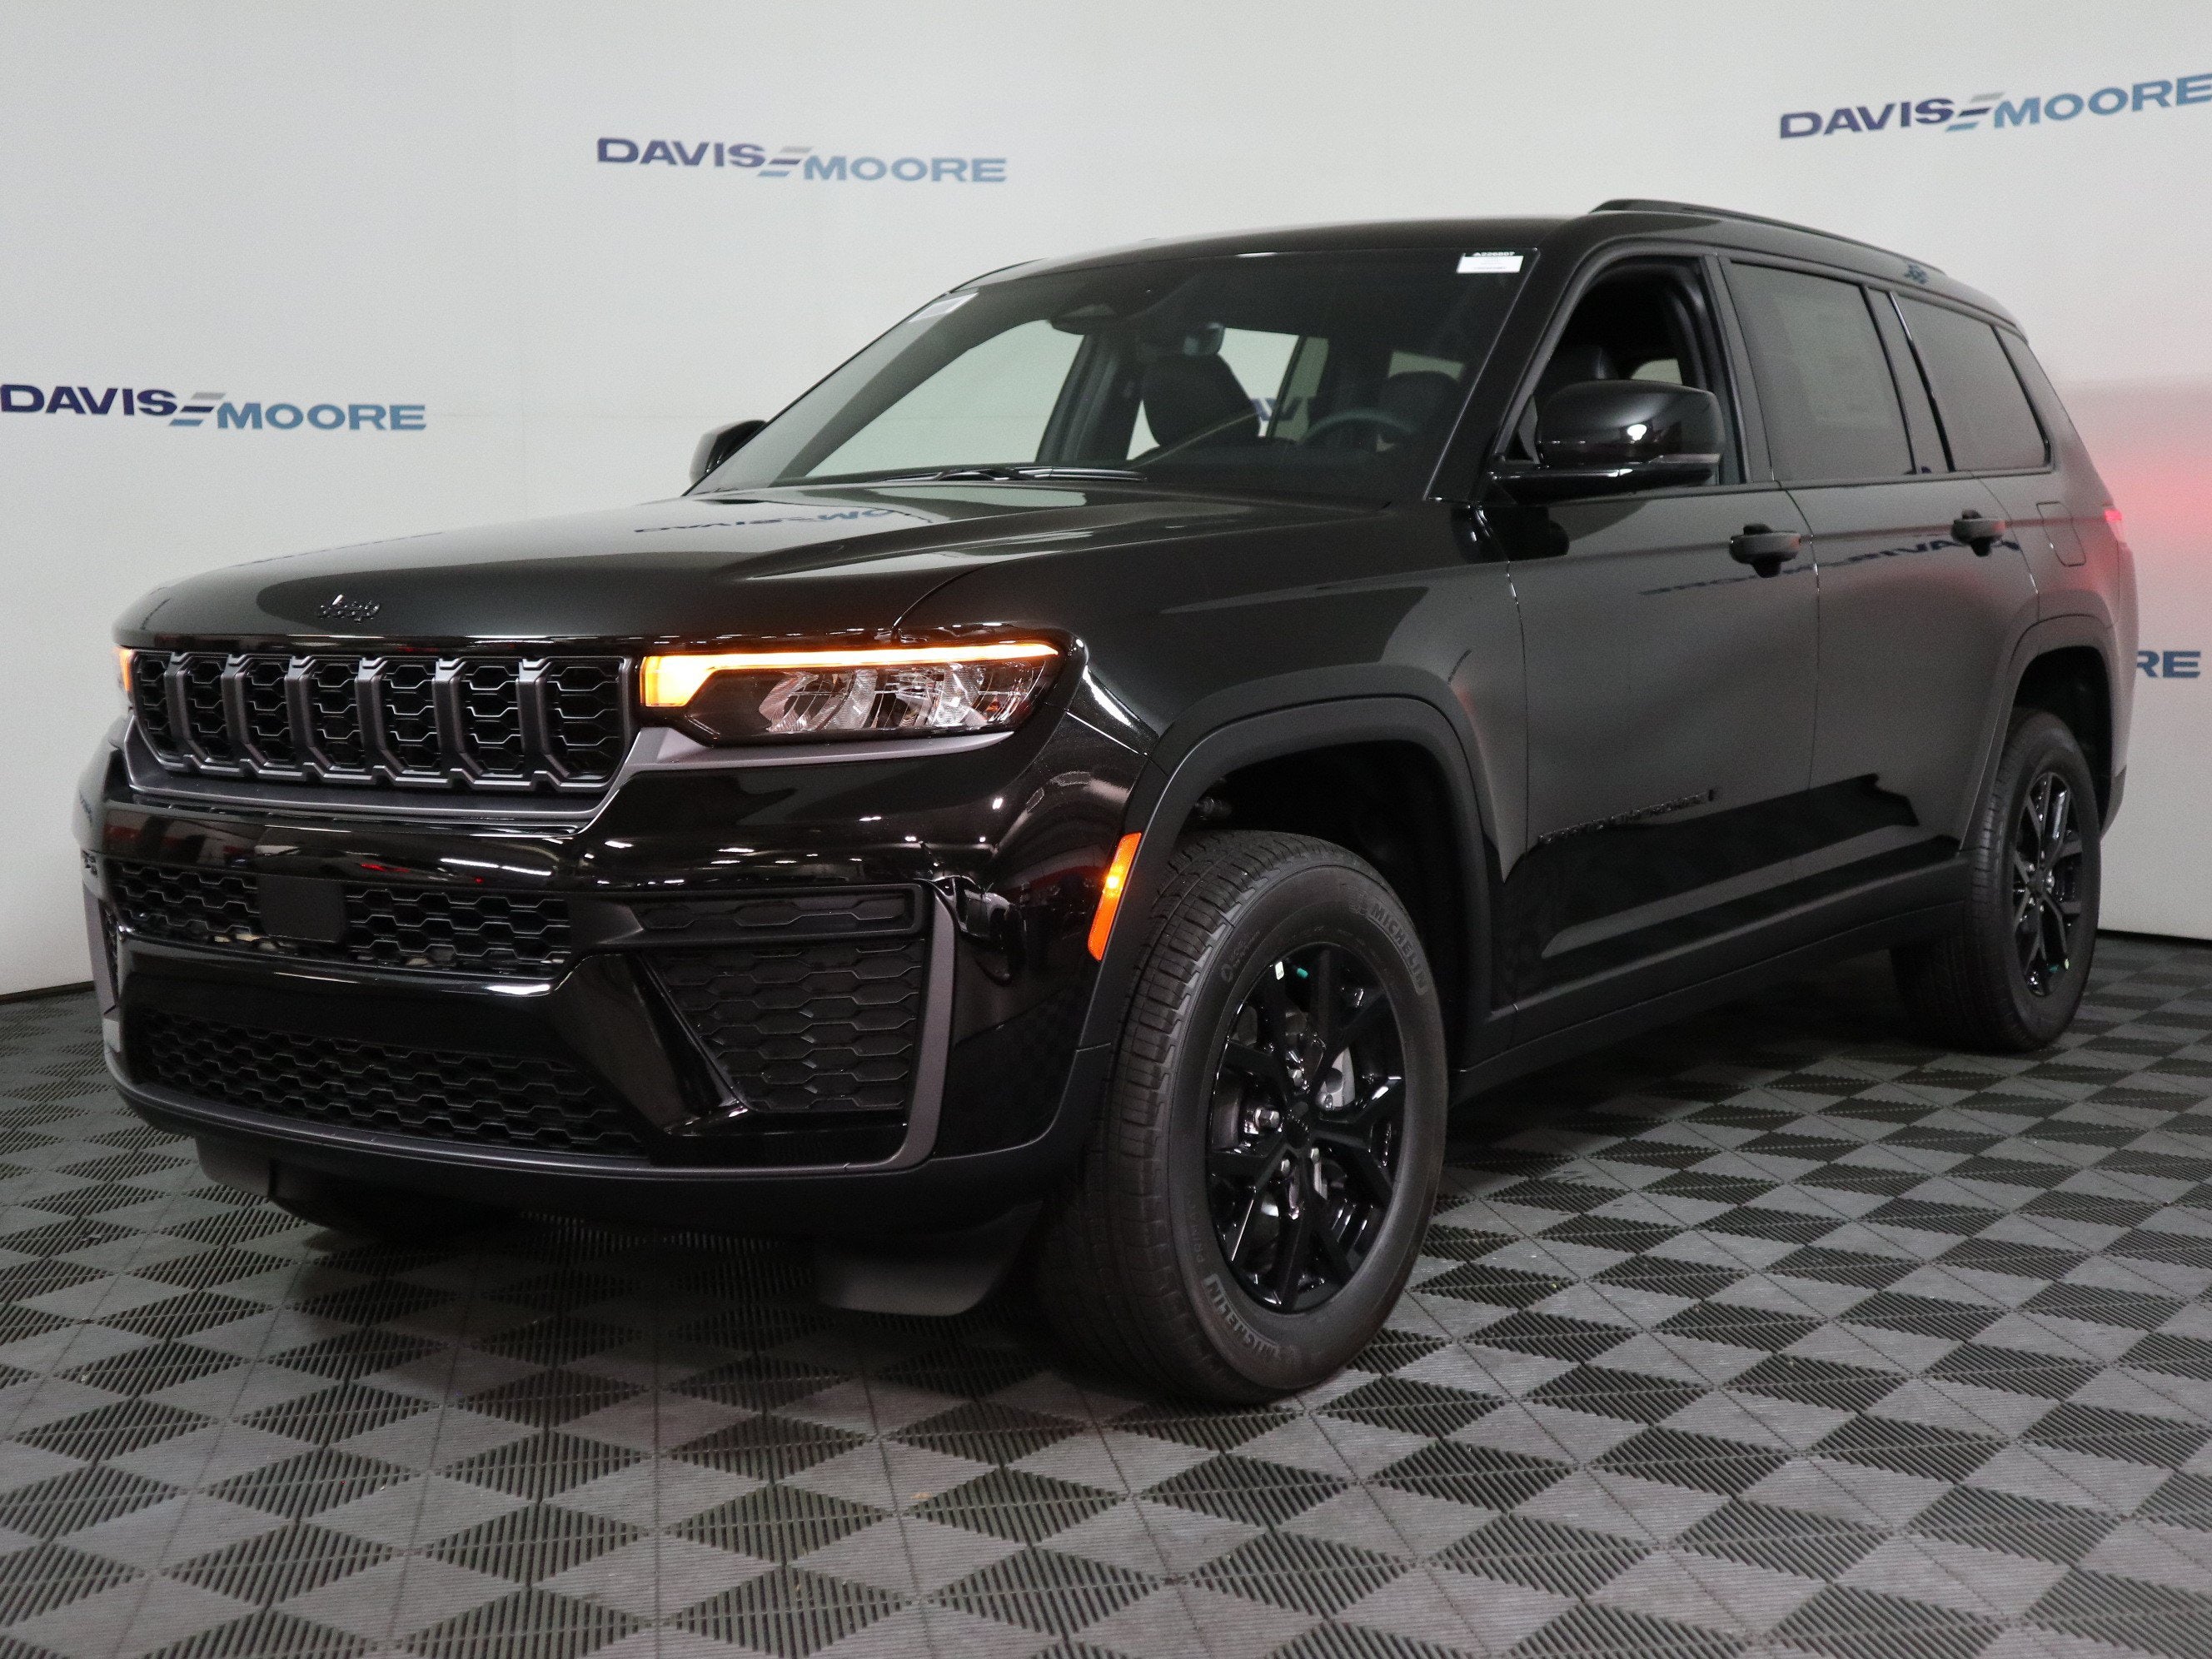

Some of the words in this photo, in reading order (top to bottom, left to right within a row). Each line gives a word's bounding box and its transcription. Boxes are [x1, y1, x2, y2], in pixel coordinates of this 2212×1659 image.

[1779, 97, 1955, 140] DAVIS
[1993, 72, 2212, 129] MOORE
[595, 137, 767, 169] DAVIS
[803, 155, 1007, 183] MOORE
[0, 382, 179, 418] DAVIS
[216, 401, 428, 431] MOORE
[1370, 902, 1427, 989] MICHELIN
